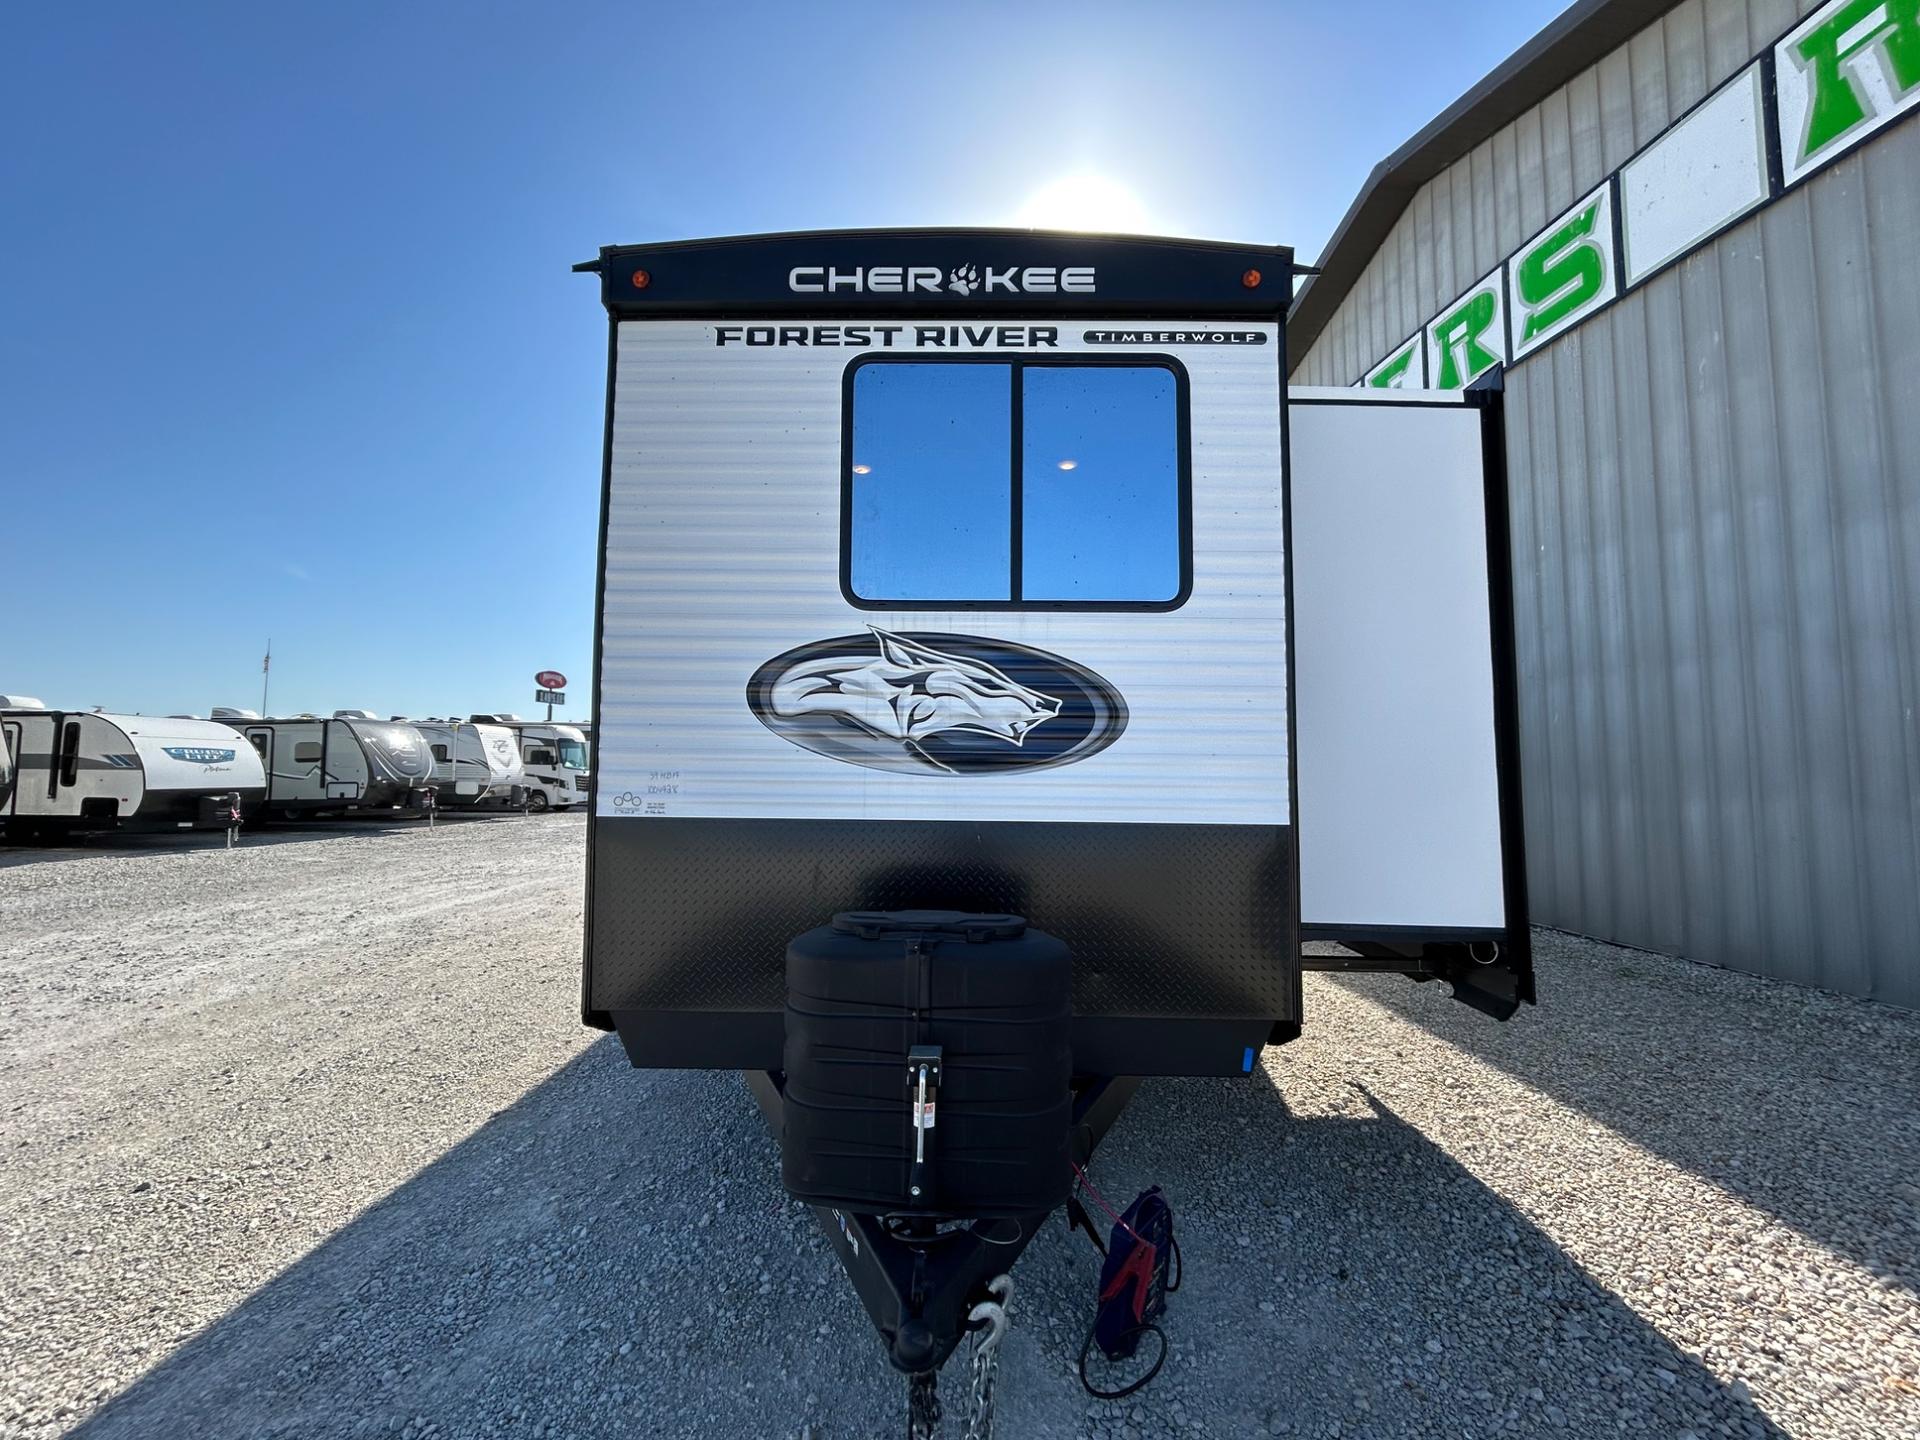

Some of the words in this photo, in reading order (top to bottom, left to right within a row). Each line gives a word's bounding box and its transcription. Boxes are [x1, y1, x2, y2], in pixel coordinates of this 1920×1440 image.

[714, 326, 903, 347] FOREST
[913, 326, 1059, 347] RIVER
[1095, 332, 1256, 343] TIMBERWOLF
